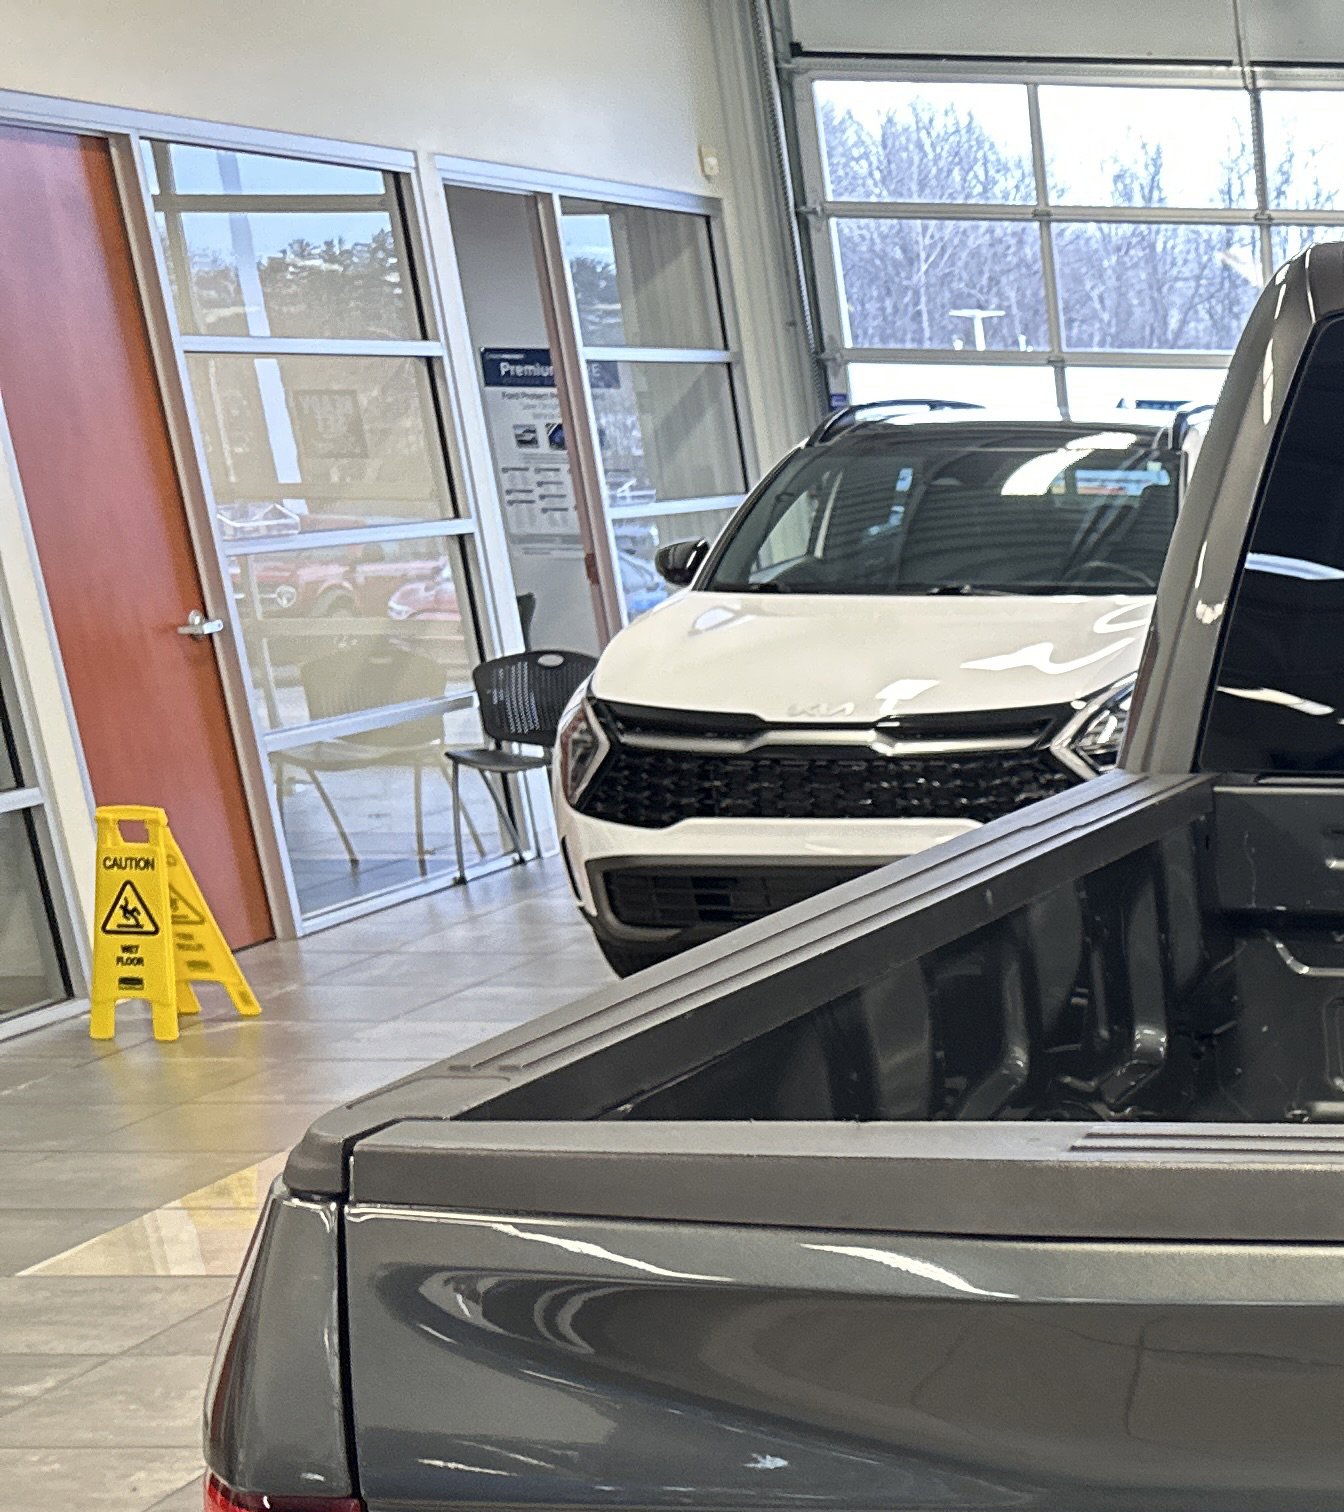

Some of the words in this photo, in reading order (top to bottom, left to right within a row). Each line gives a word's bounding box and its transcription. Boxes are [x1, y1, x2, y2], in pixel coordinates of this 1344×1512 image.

[103, 856, 155, 871] CAUTION
[120, 944, 140, 955] WET
[116, 956, 144, 967] FLOOR
